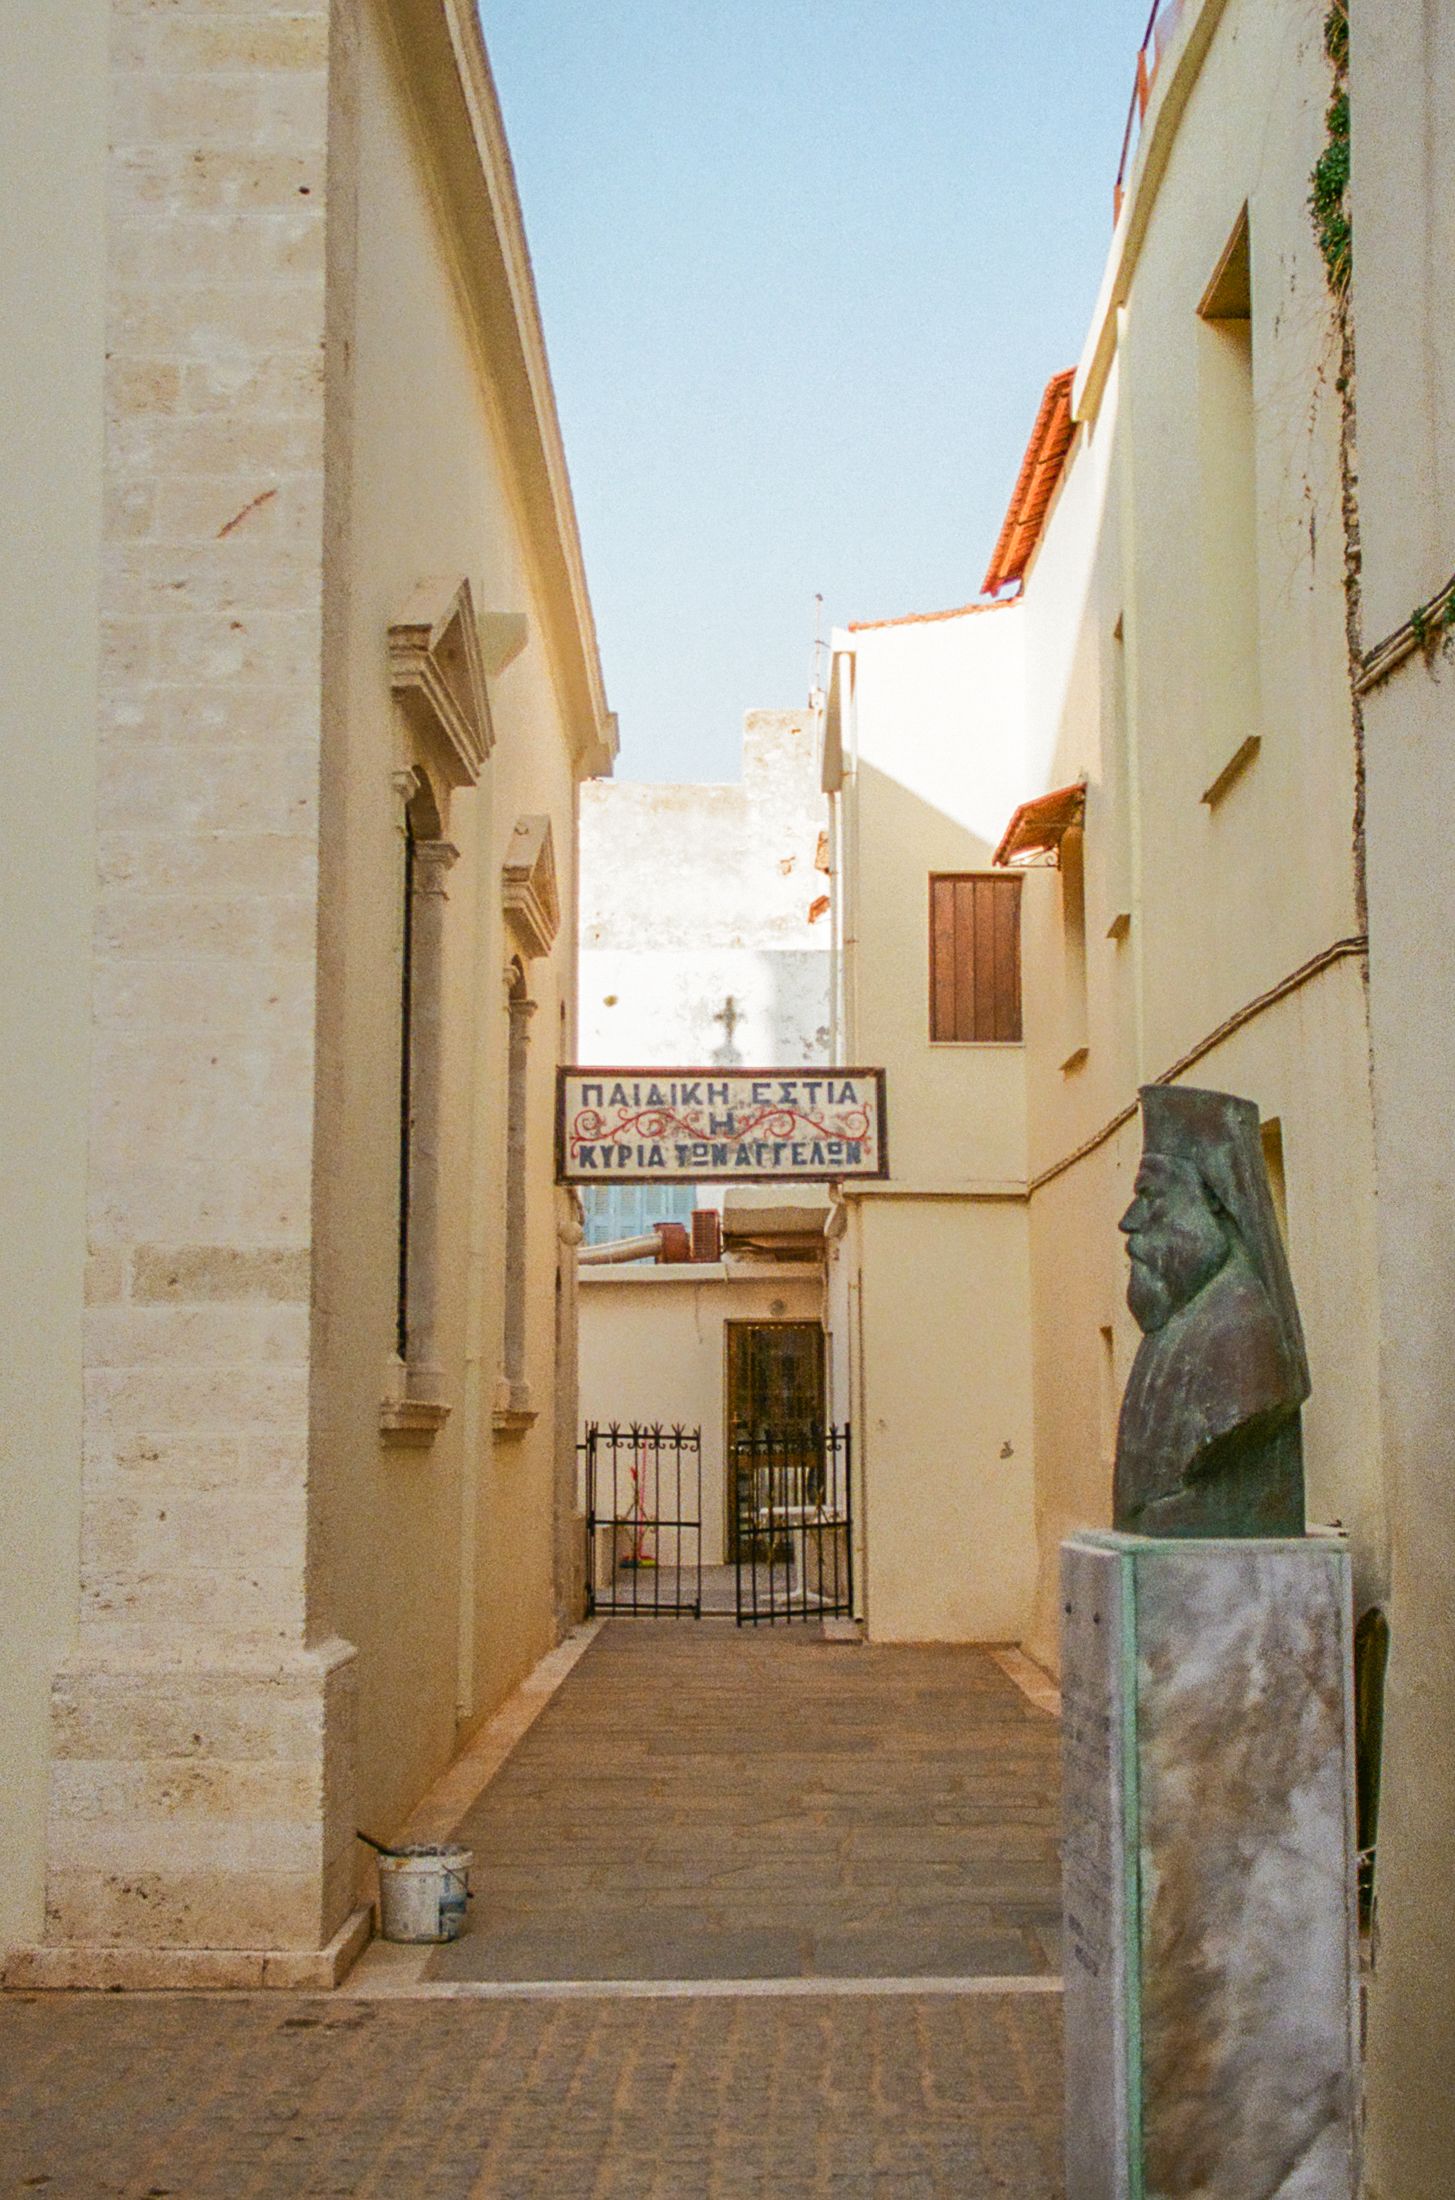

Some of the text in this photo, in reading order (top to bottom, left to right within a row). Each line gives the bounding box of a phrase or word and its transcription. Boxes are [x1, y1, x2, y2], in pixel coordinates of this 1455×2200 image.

[582, 1081, 858, 1107] ΠΑΙΔΙΚΗ ΕΣΤΙΑ
[709, 1112, 734, 1135] Η
[578, 1141, 862, 1169] ΚΥΡΙΑ ΤΩΝ ΑΓΓΕΛΩΝ
